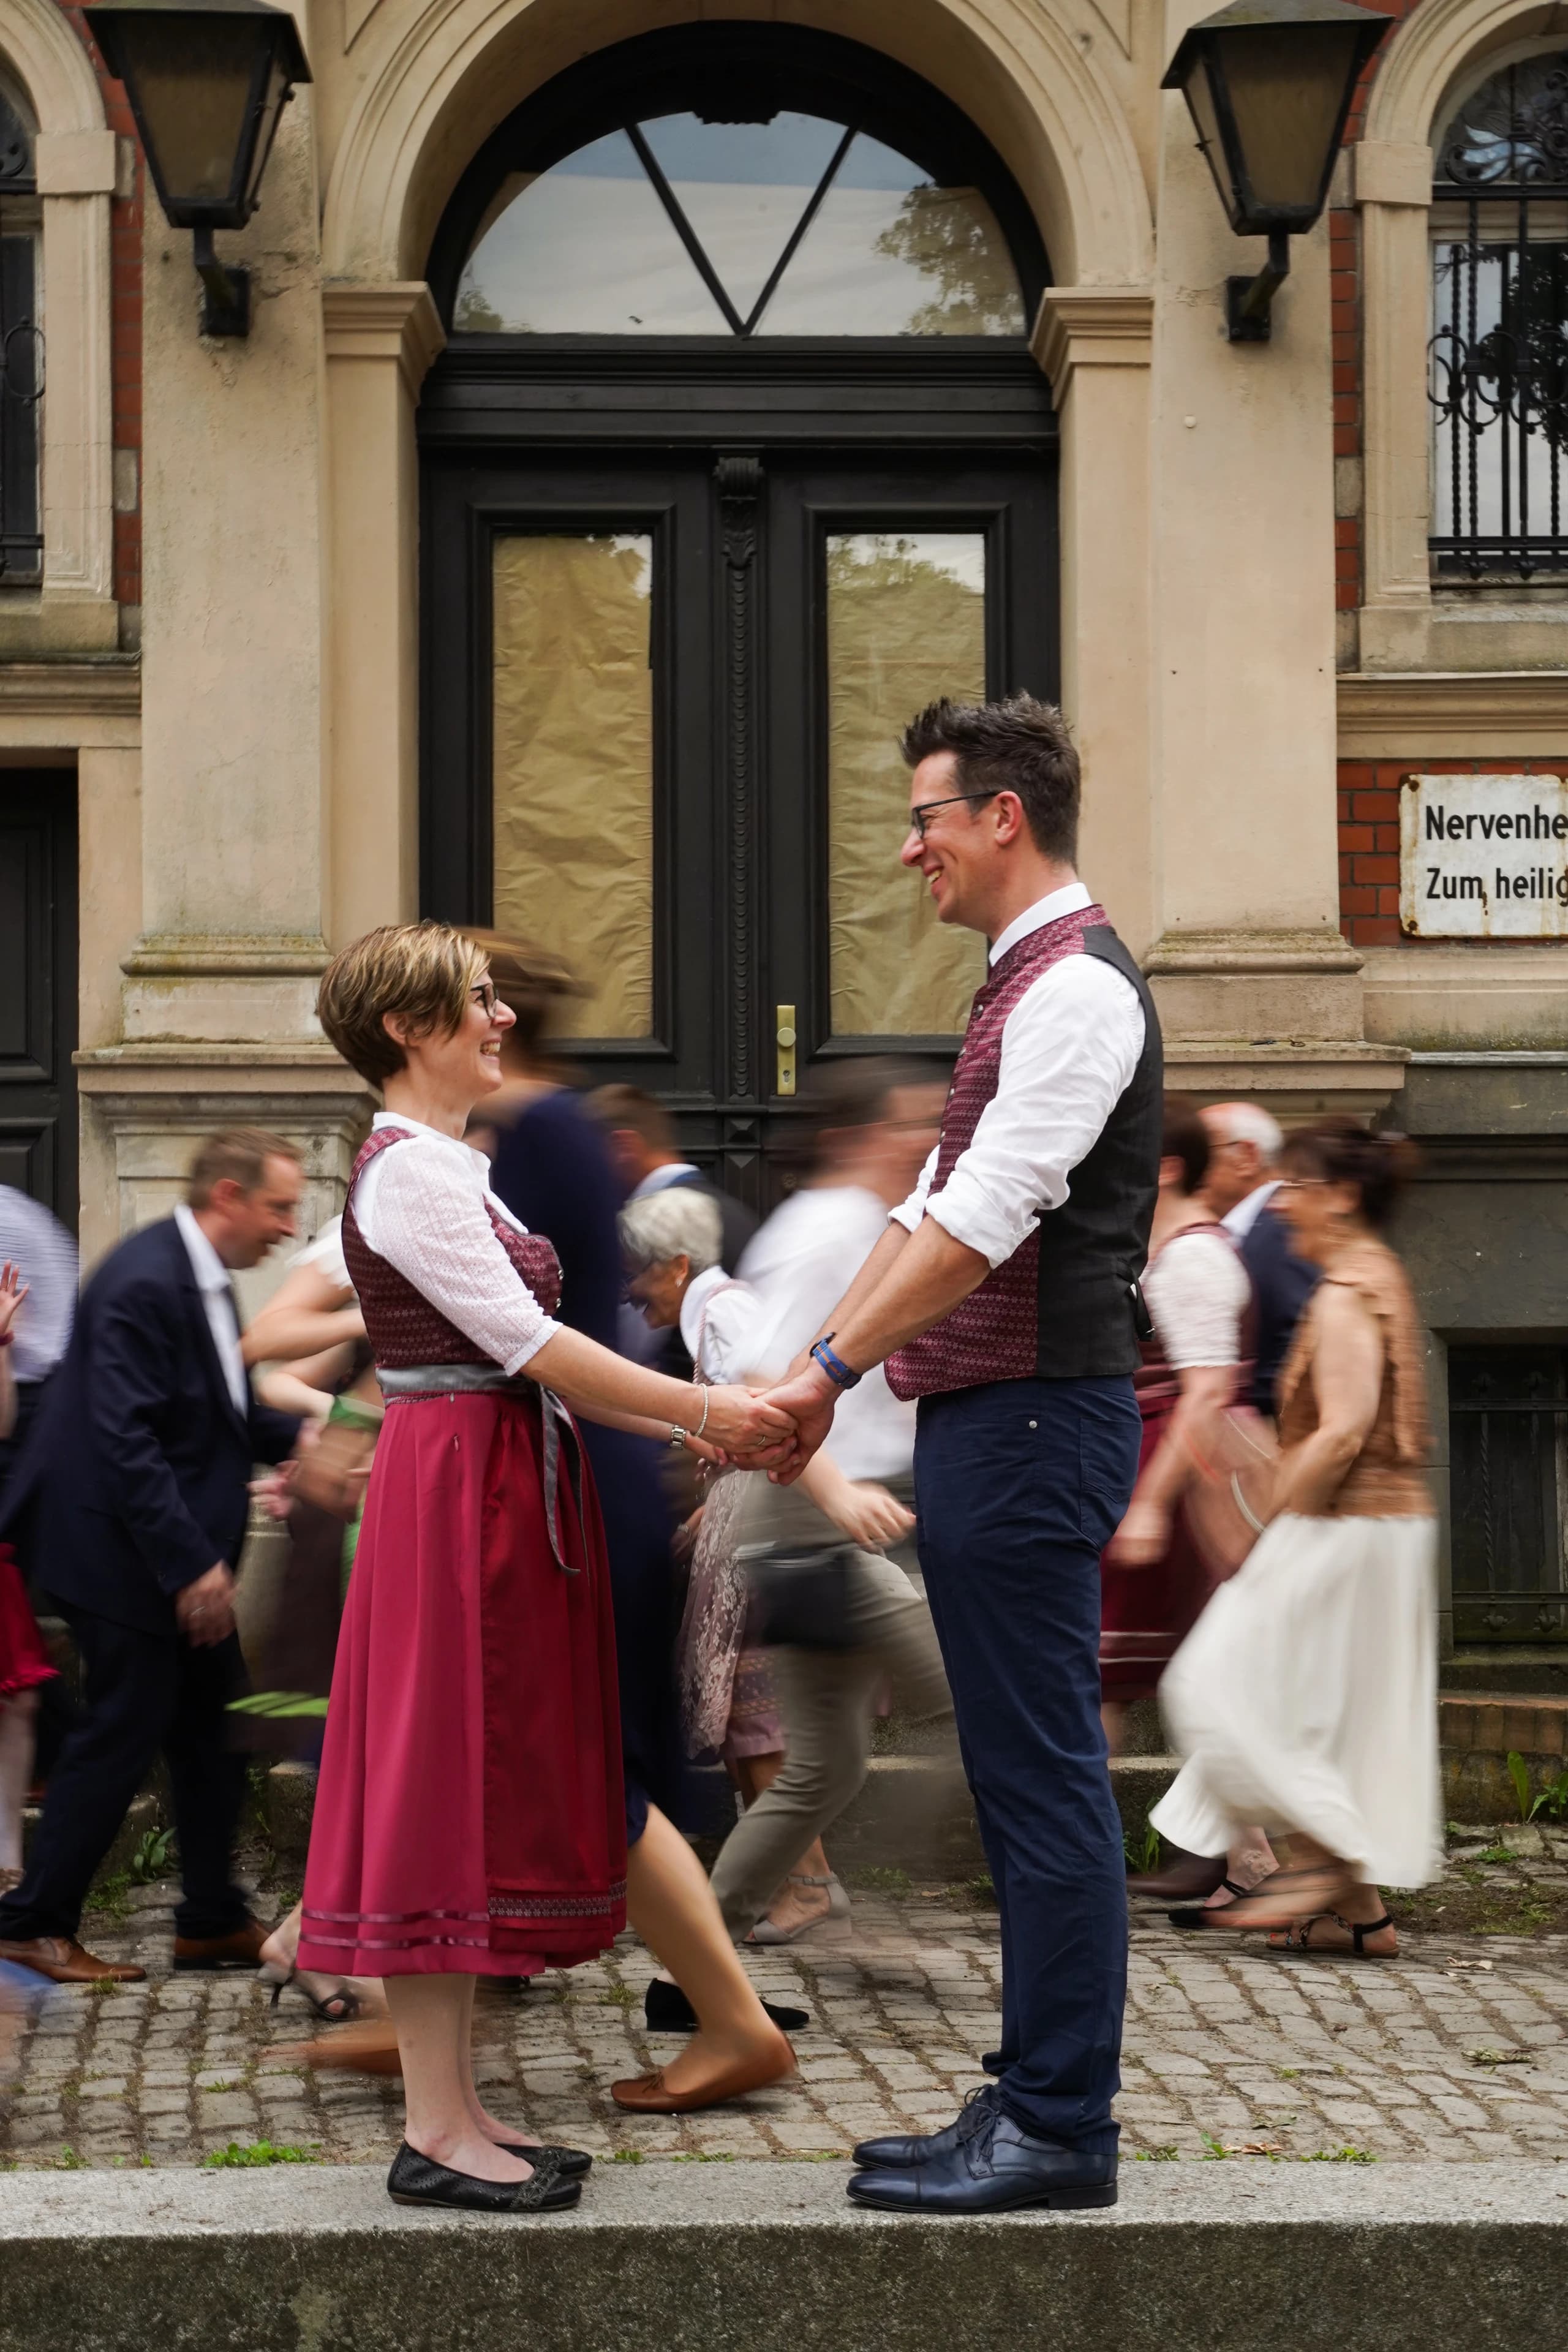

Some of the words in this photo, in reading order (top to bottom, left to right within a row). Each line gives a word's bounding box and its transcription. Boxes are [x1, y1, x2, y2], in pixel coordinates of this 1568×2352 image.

[1426, 804, 1568, 840] Nervenhe
[1427, 868, 1483, 899] Zum
[1496, 868, 1568, 907] heilig
